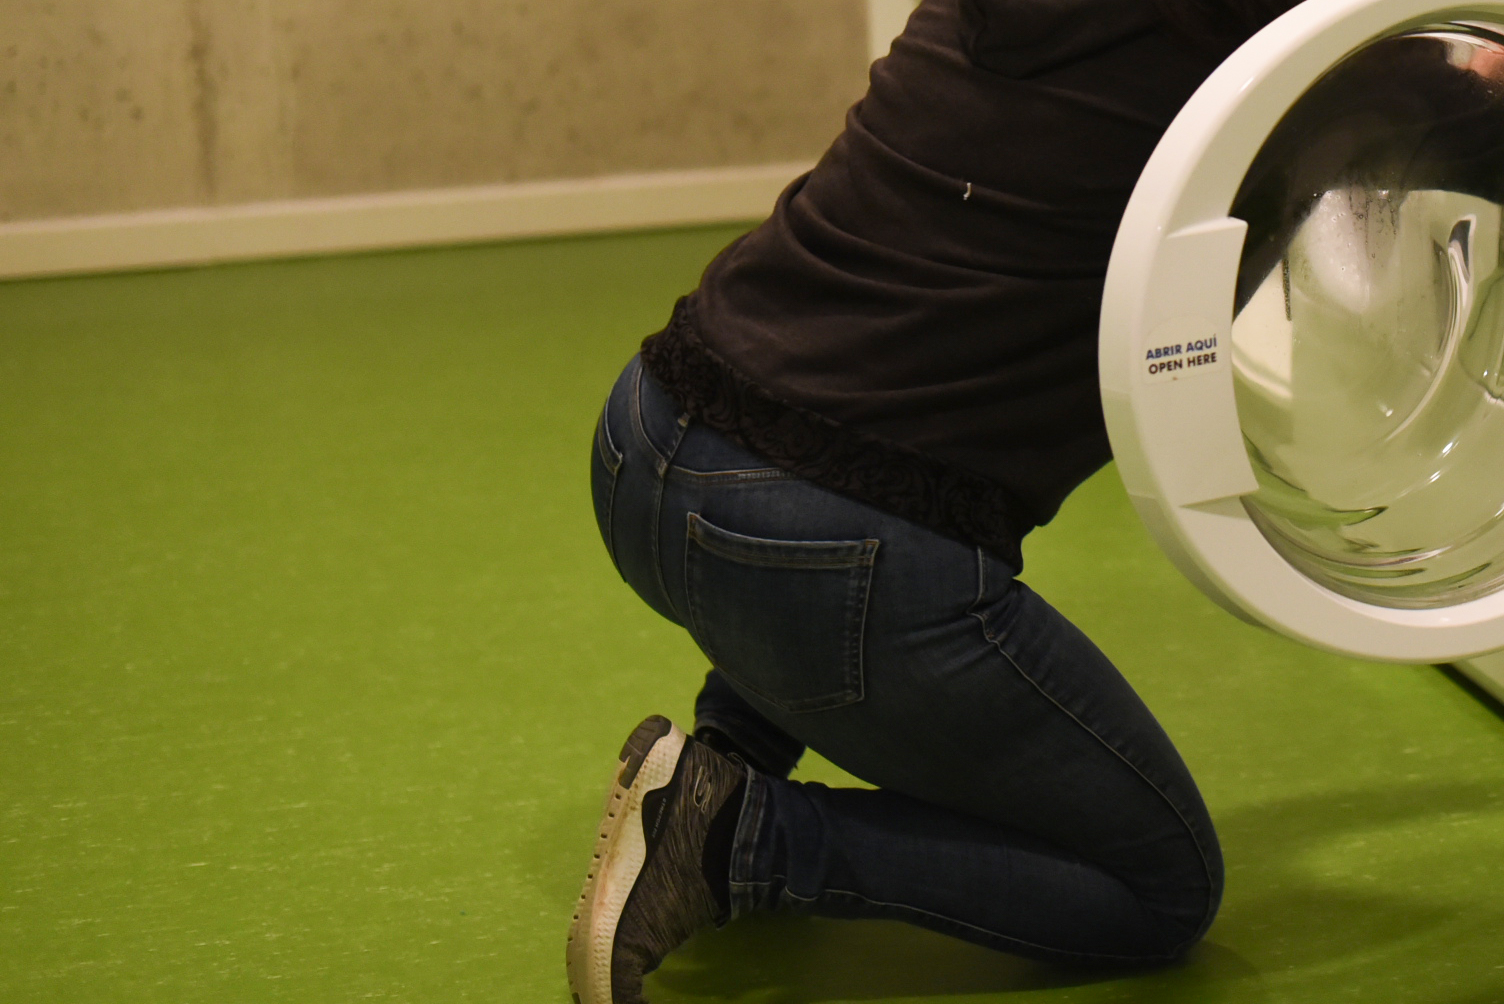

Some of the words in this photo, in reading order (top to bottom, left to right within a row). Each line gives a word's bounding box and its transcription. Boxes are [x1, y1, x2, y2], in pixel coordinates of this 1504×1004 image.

[1146, 344, 1182, 360] ABRIR
[1186, 333, 1217, 353] AQUÍ
[1148, 358, 1183, 374] OPEN
[1187, 352, 1217, 368] HERE
